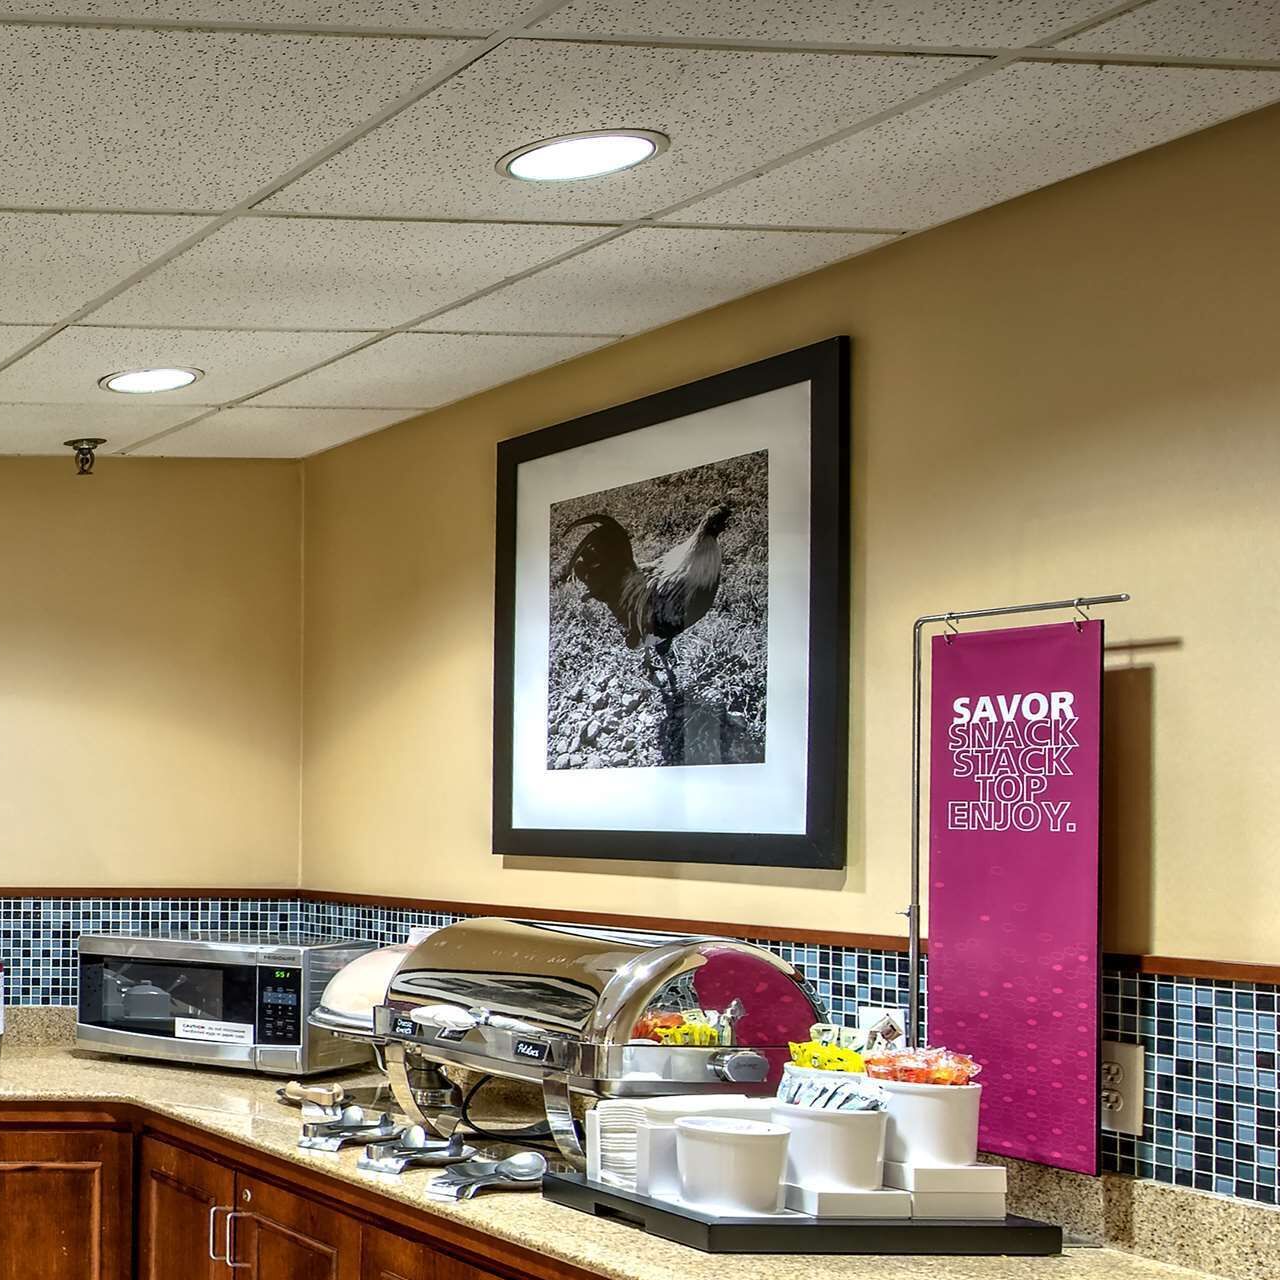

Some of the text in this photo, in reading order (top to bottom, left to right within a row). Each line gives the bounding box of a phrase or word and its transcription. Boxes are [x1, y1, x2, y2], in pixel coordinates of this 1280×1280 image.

[952, 691, 1076, 725] SAVOR
[948, 716, 1080, 751] SNACK
[953, 745, 1074, 777] STACK
[974, 773, 1048, 804] TOP
[948, 801, 1077, 832] ENJOY.
